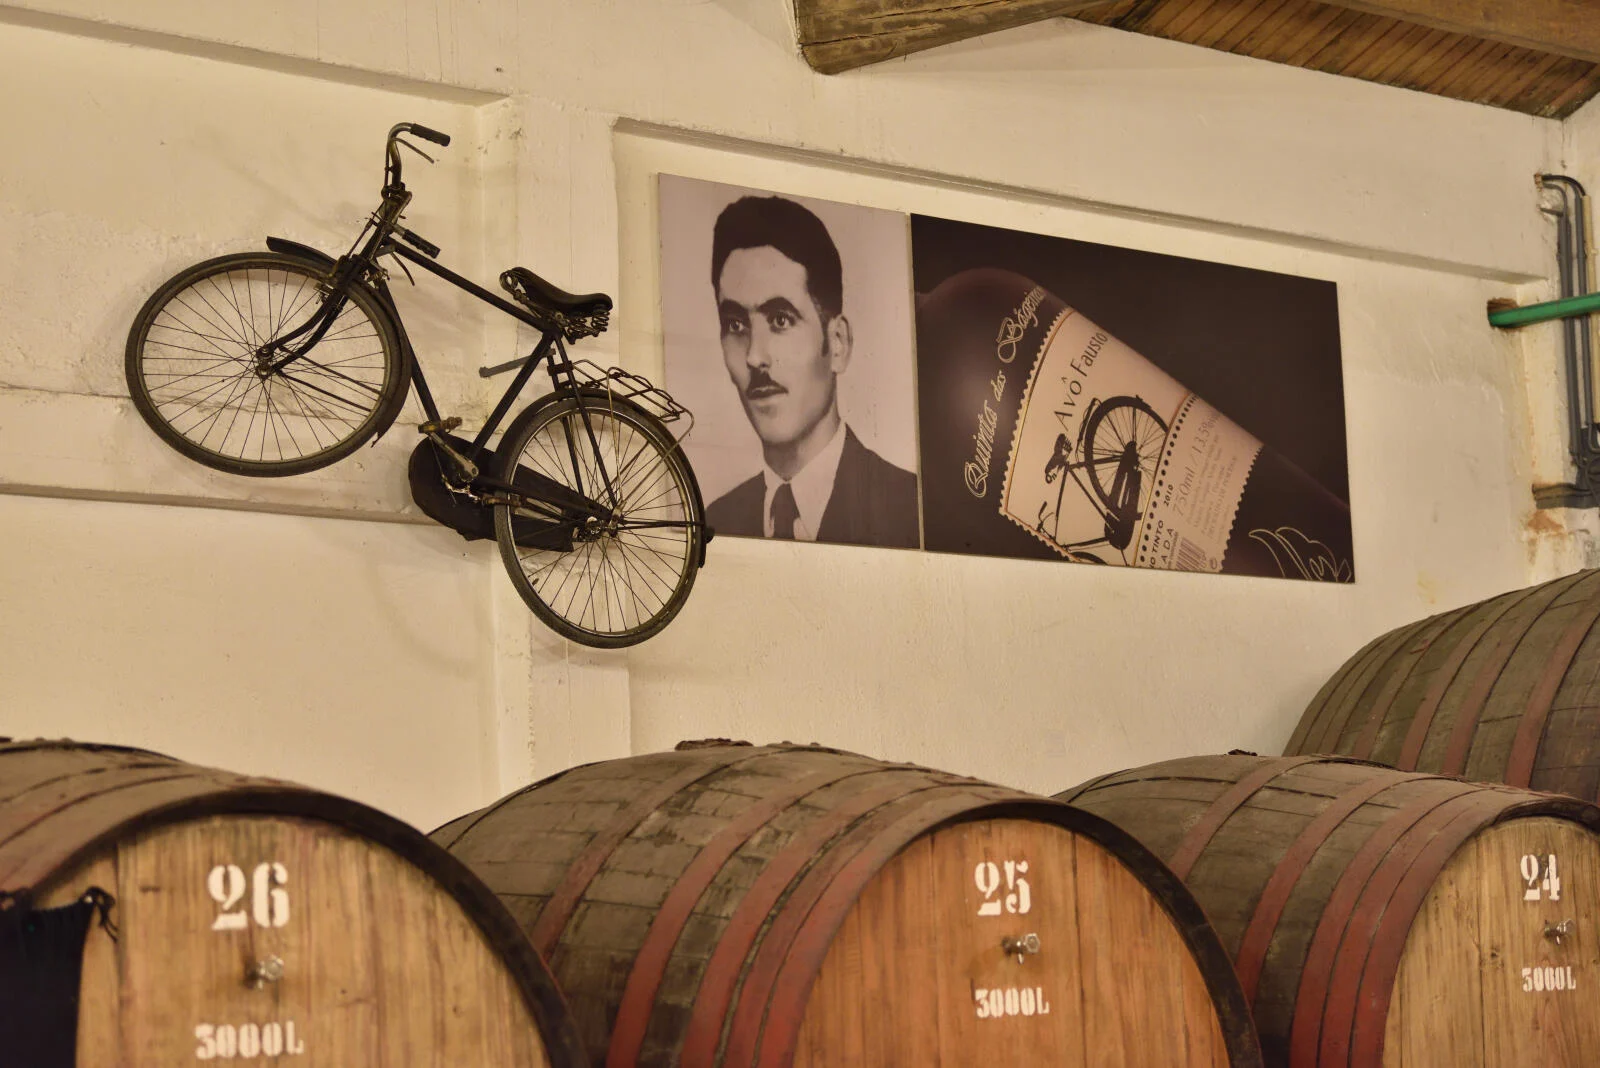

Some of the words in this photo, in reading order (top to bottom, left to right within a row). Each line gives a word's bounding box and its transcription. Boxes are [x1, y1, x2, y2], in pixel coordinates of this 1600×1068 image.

[1054, 376, 1083, 432] Avô
[1070, 331, 1109, 378] Fausto
[964, 400, 998, 498] Quinta
[991, 370, 1007, 402] das
[1163, 484, 1174, 507] 2010
[1151, 520, 1164, 554] TINTO
[207, 862, 290, 931] 26
[974, 860, 1031, 916] 25
[1520, 854, 1560, 901] 24
[974, 986, 1050, 1018] 3000L
[194, 1020, 304, 1060] 3000L
